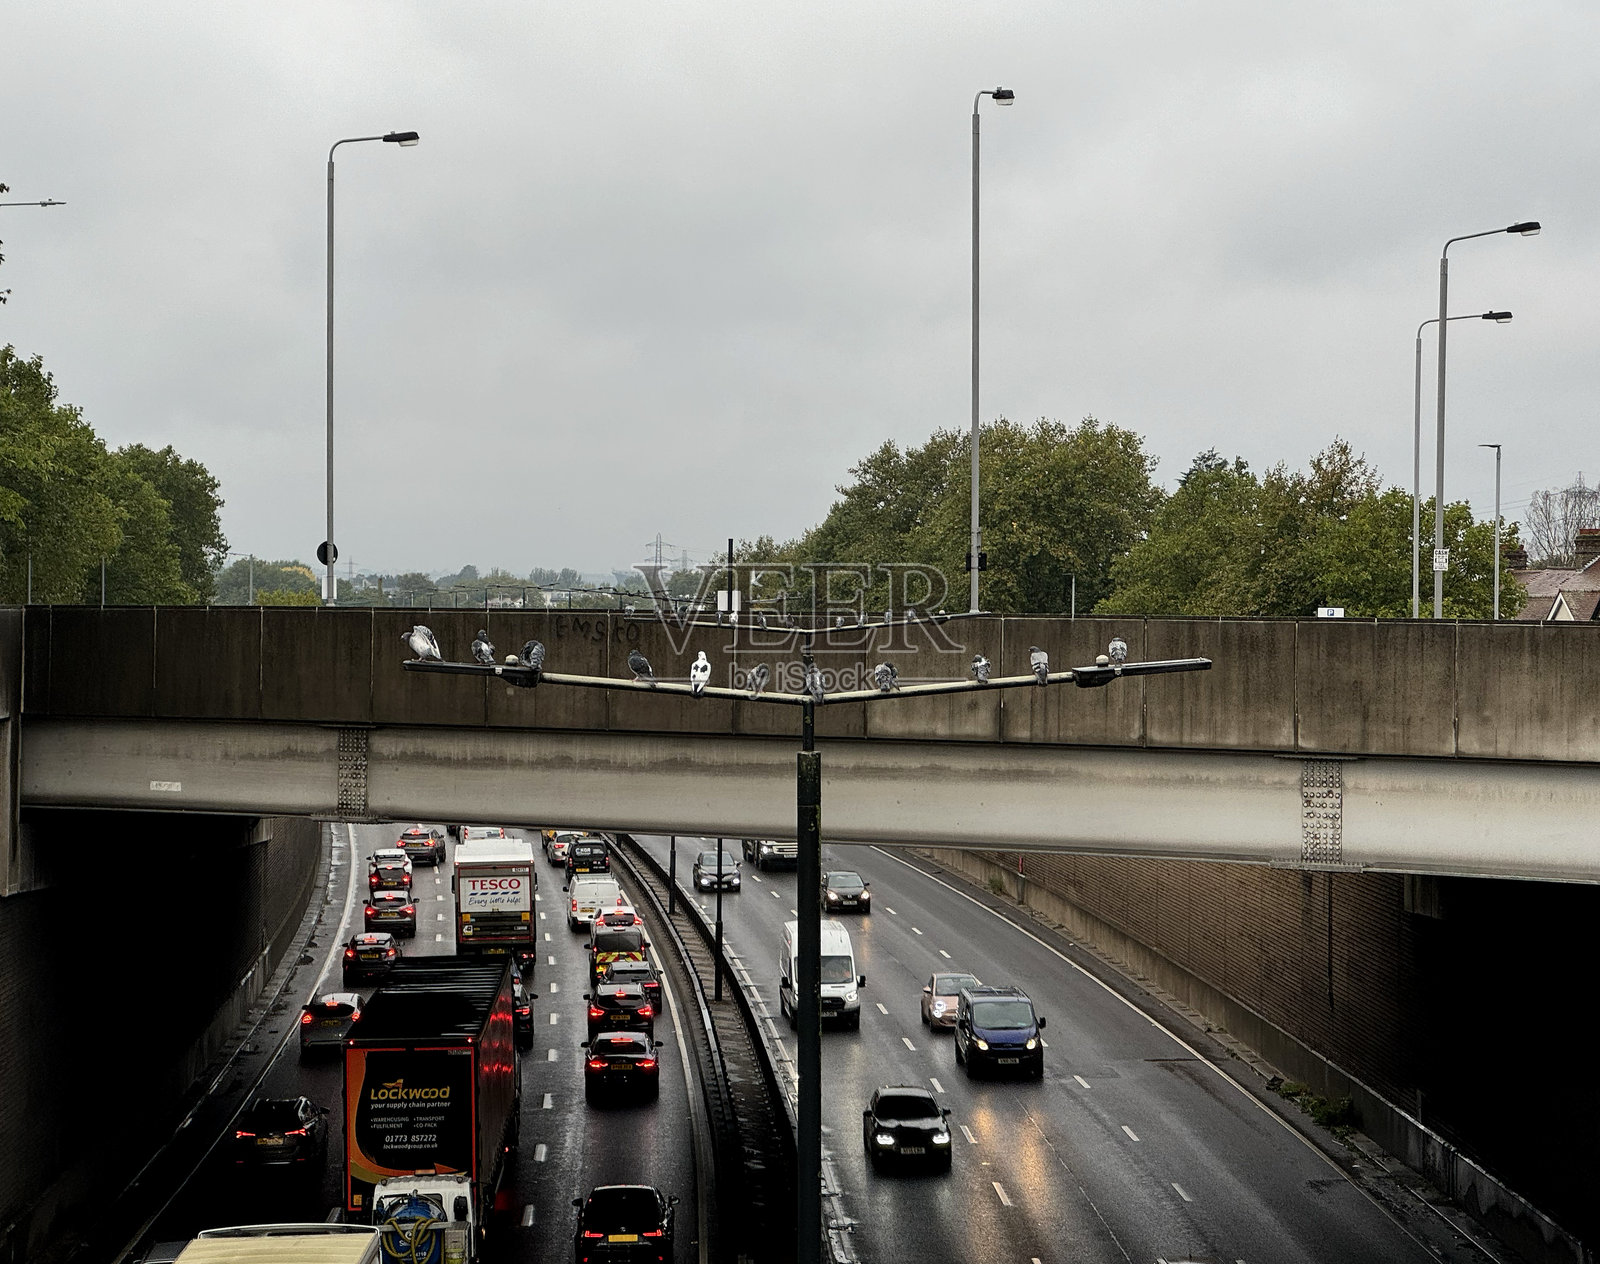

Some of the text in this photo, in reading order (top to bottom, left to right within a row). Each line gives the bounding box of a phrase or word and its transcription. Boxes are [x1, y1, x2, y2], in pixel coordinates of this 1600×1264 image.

[468, 878, 521, 891] TESCO
[468, 897, 488, 907] Every
[506, 896, 521, 905] helps
[370, 1102, 386, 1110] your
[386, 1101, 408, 1109] supply
[426, 1101, 451, 1109] partner
[385, 1135, 408, 1143] 01773
